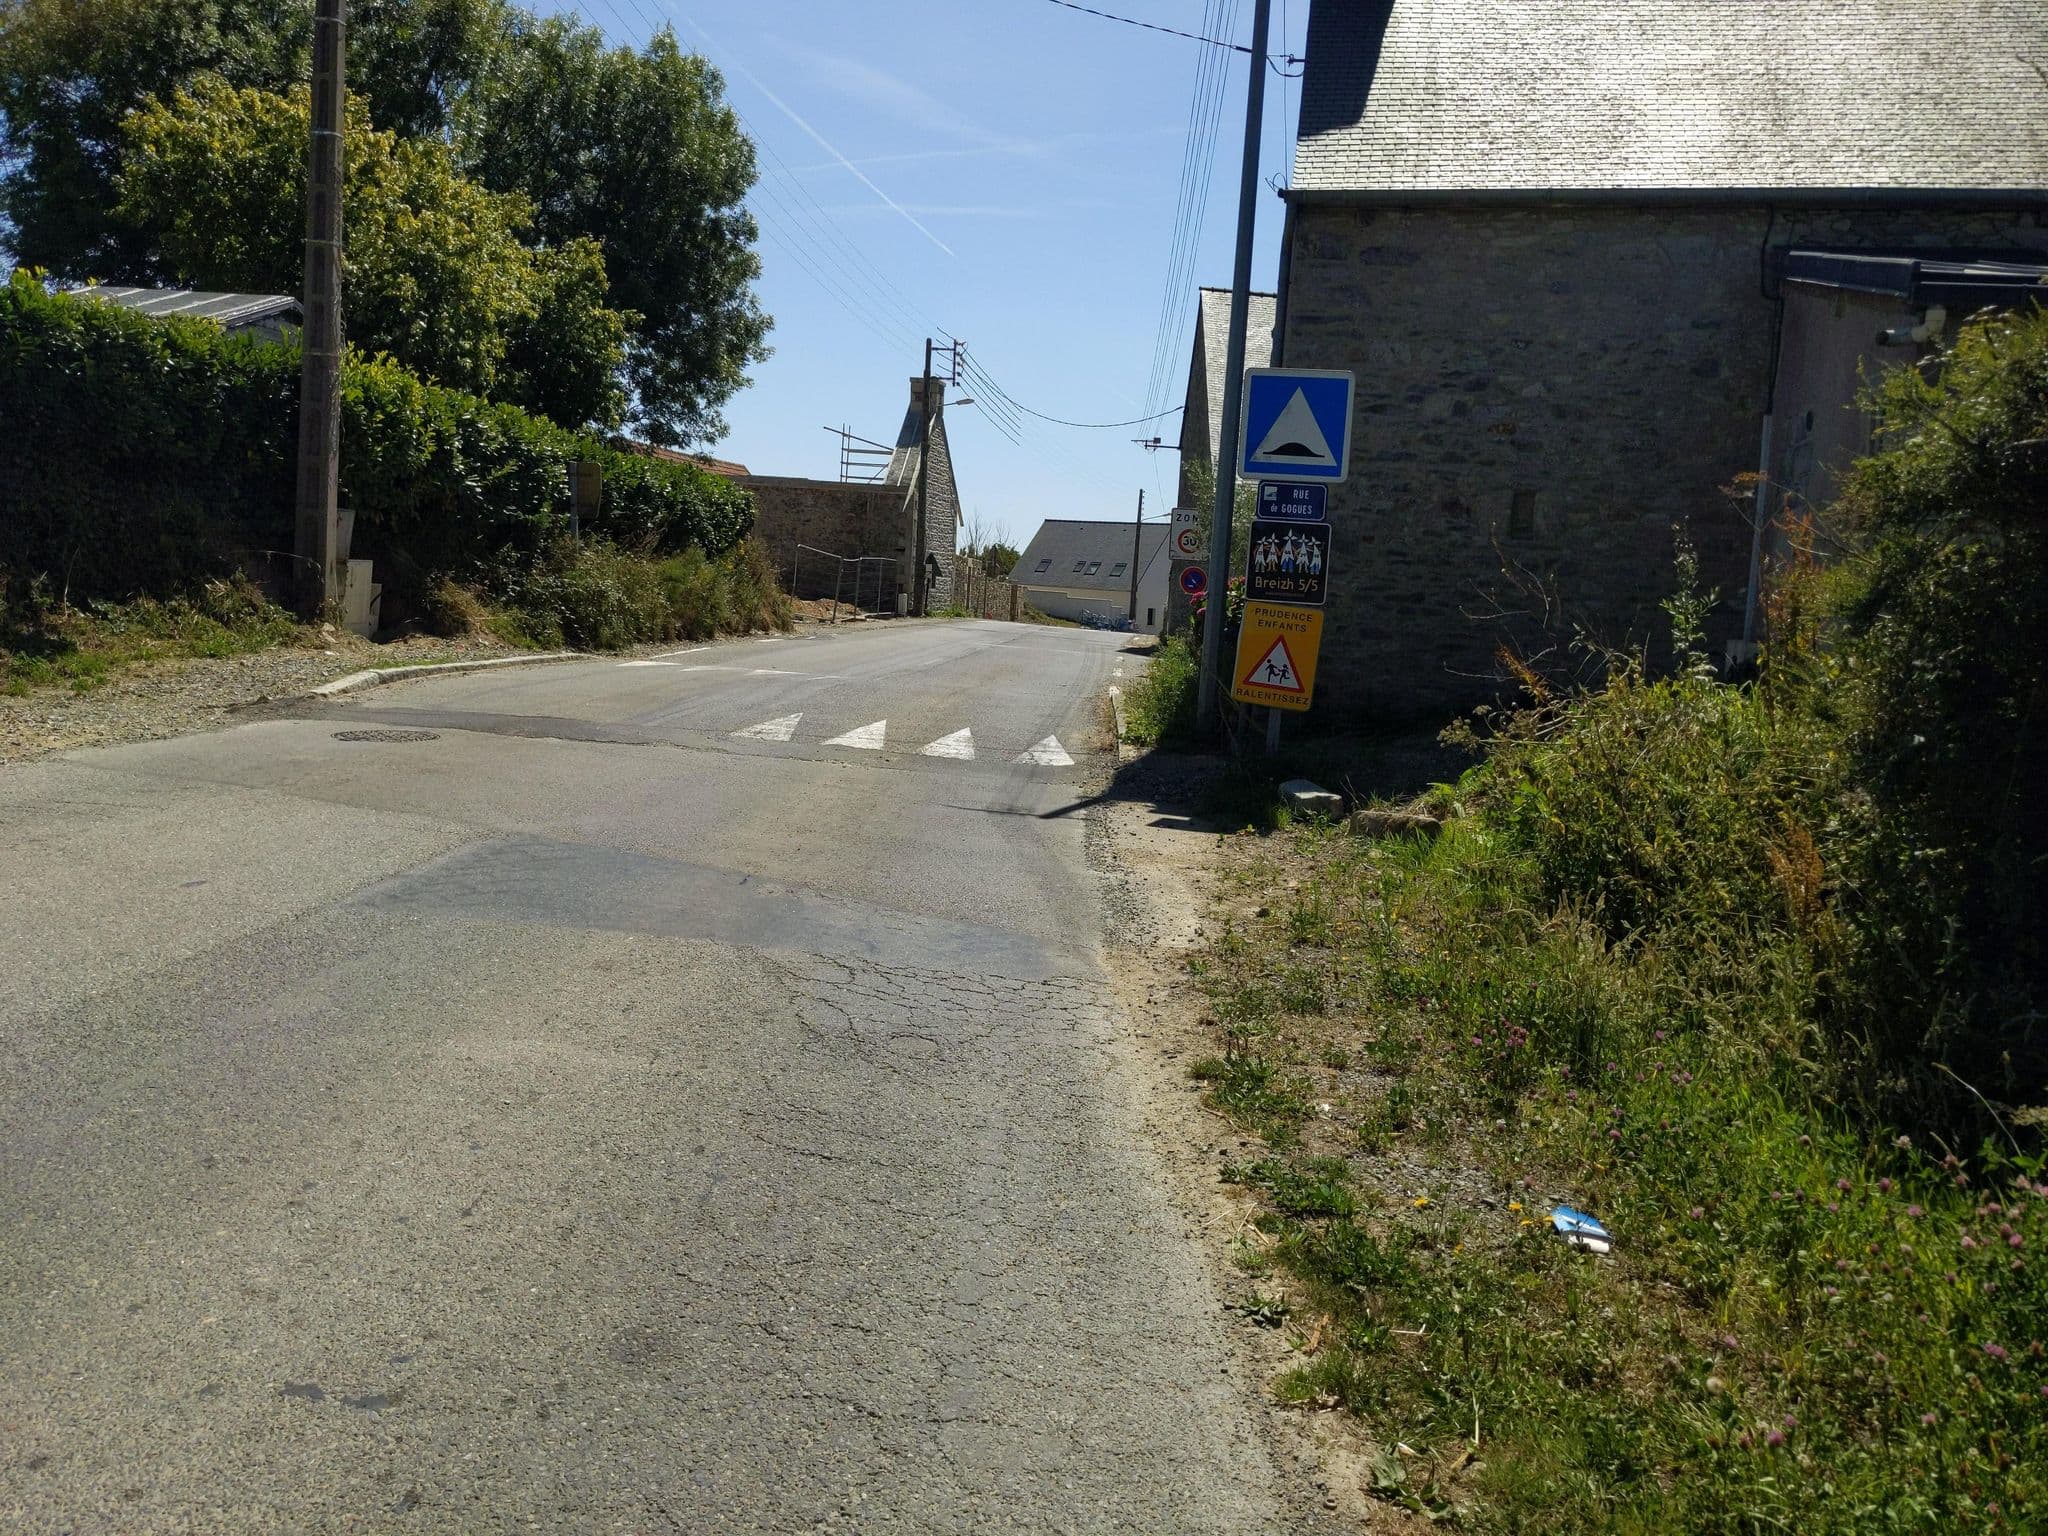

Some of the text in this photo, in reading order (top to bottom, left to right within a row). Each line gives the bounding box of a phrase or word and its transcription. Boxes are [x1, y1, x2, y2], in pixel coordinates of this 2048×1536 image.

[1293, 489, 1310, 500] RUE
[1281, 503, 1313, 515] GOGUES
[1176, 513, 1200, 522] ZON
[1255, 576, 1319, 593] Breizh 5/5
[1254, 607, 1314, 622] PRUDENCE
[1257, 619, 1307, 632] ENFANTS
[1235, 687, 1310, 705] RALENTISSEZ
